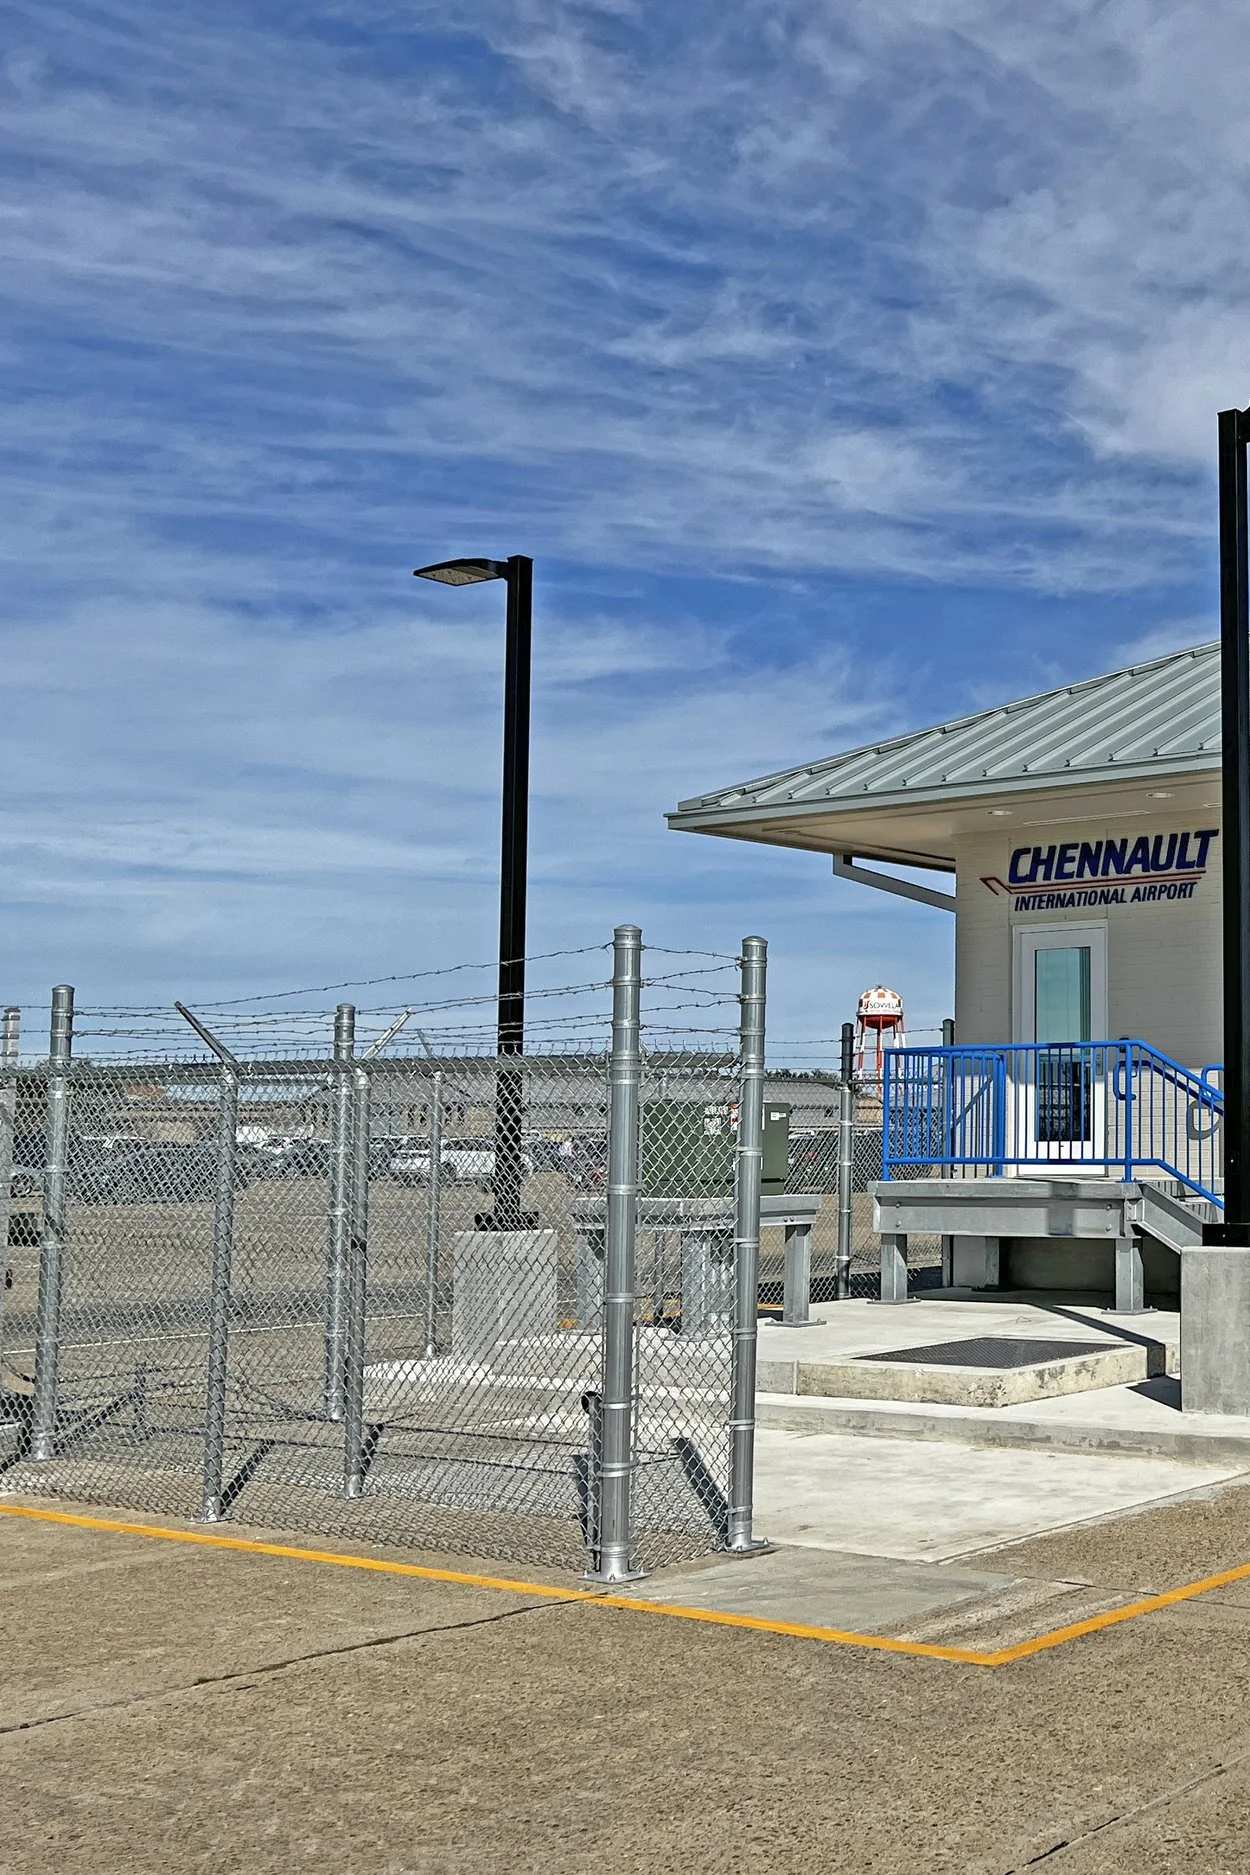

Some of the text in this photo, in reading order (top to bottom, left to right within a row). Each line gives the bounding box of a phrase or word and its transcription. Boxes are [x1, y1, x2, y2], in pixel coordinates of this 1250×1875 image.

[1008, 828, 1220, 884] CHENNAULT
[1014, 881, 1198, 911] INTERNATIONAL AIRPORT
